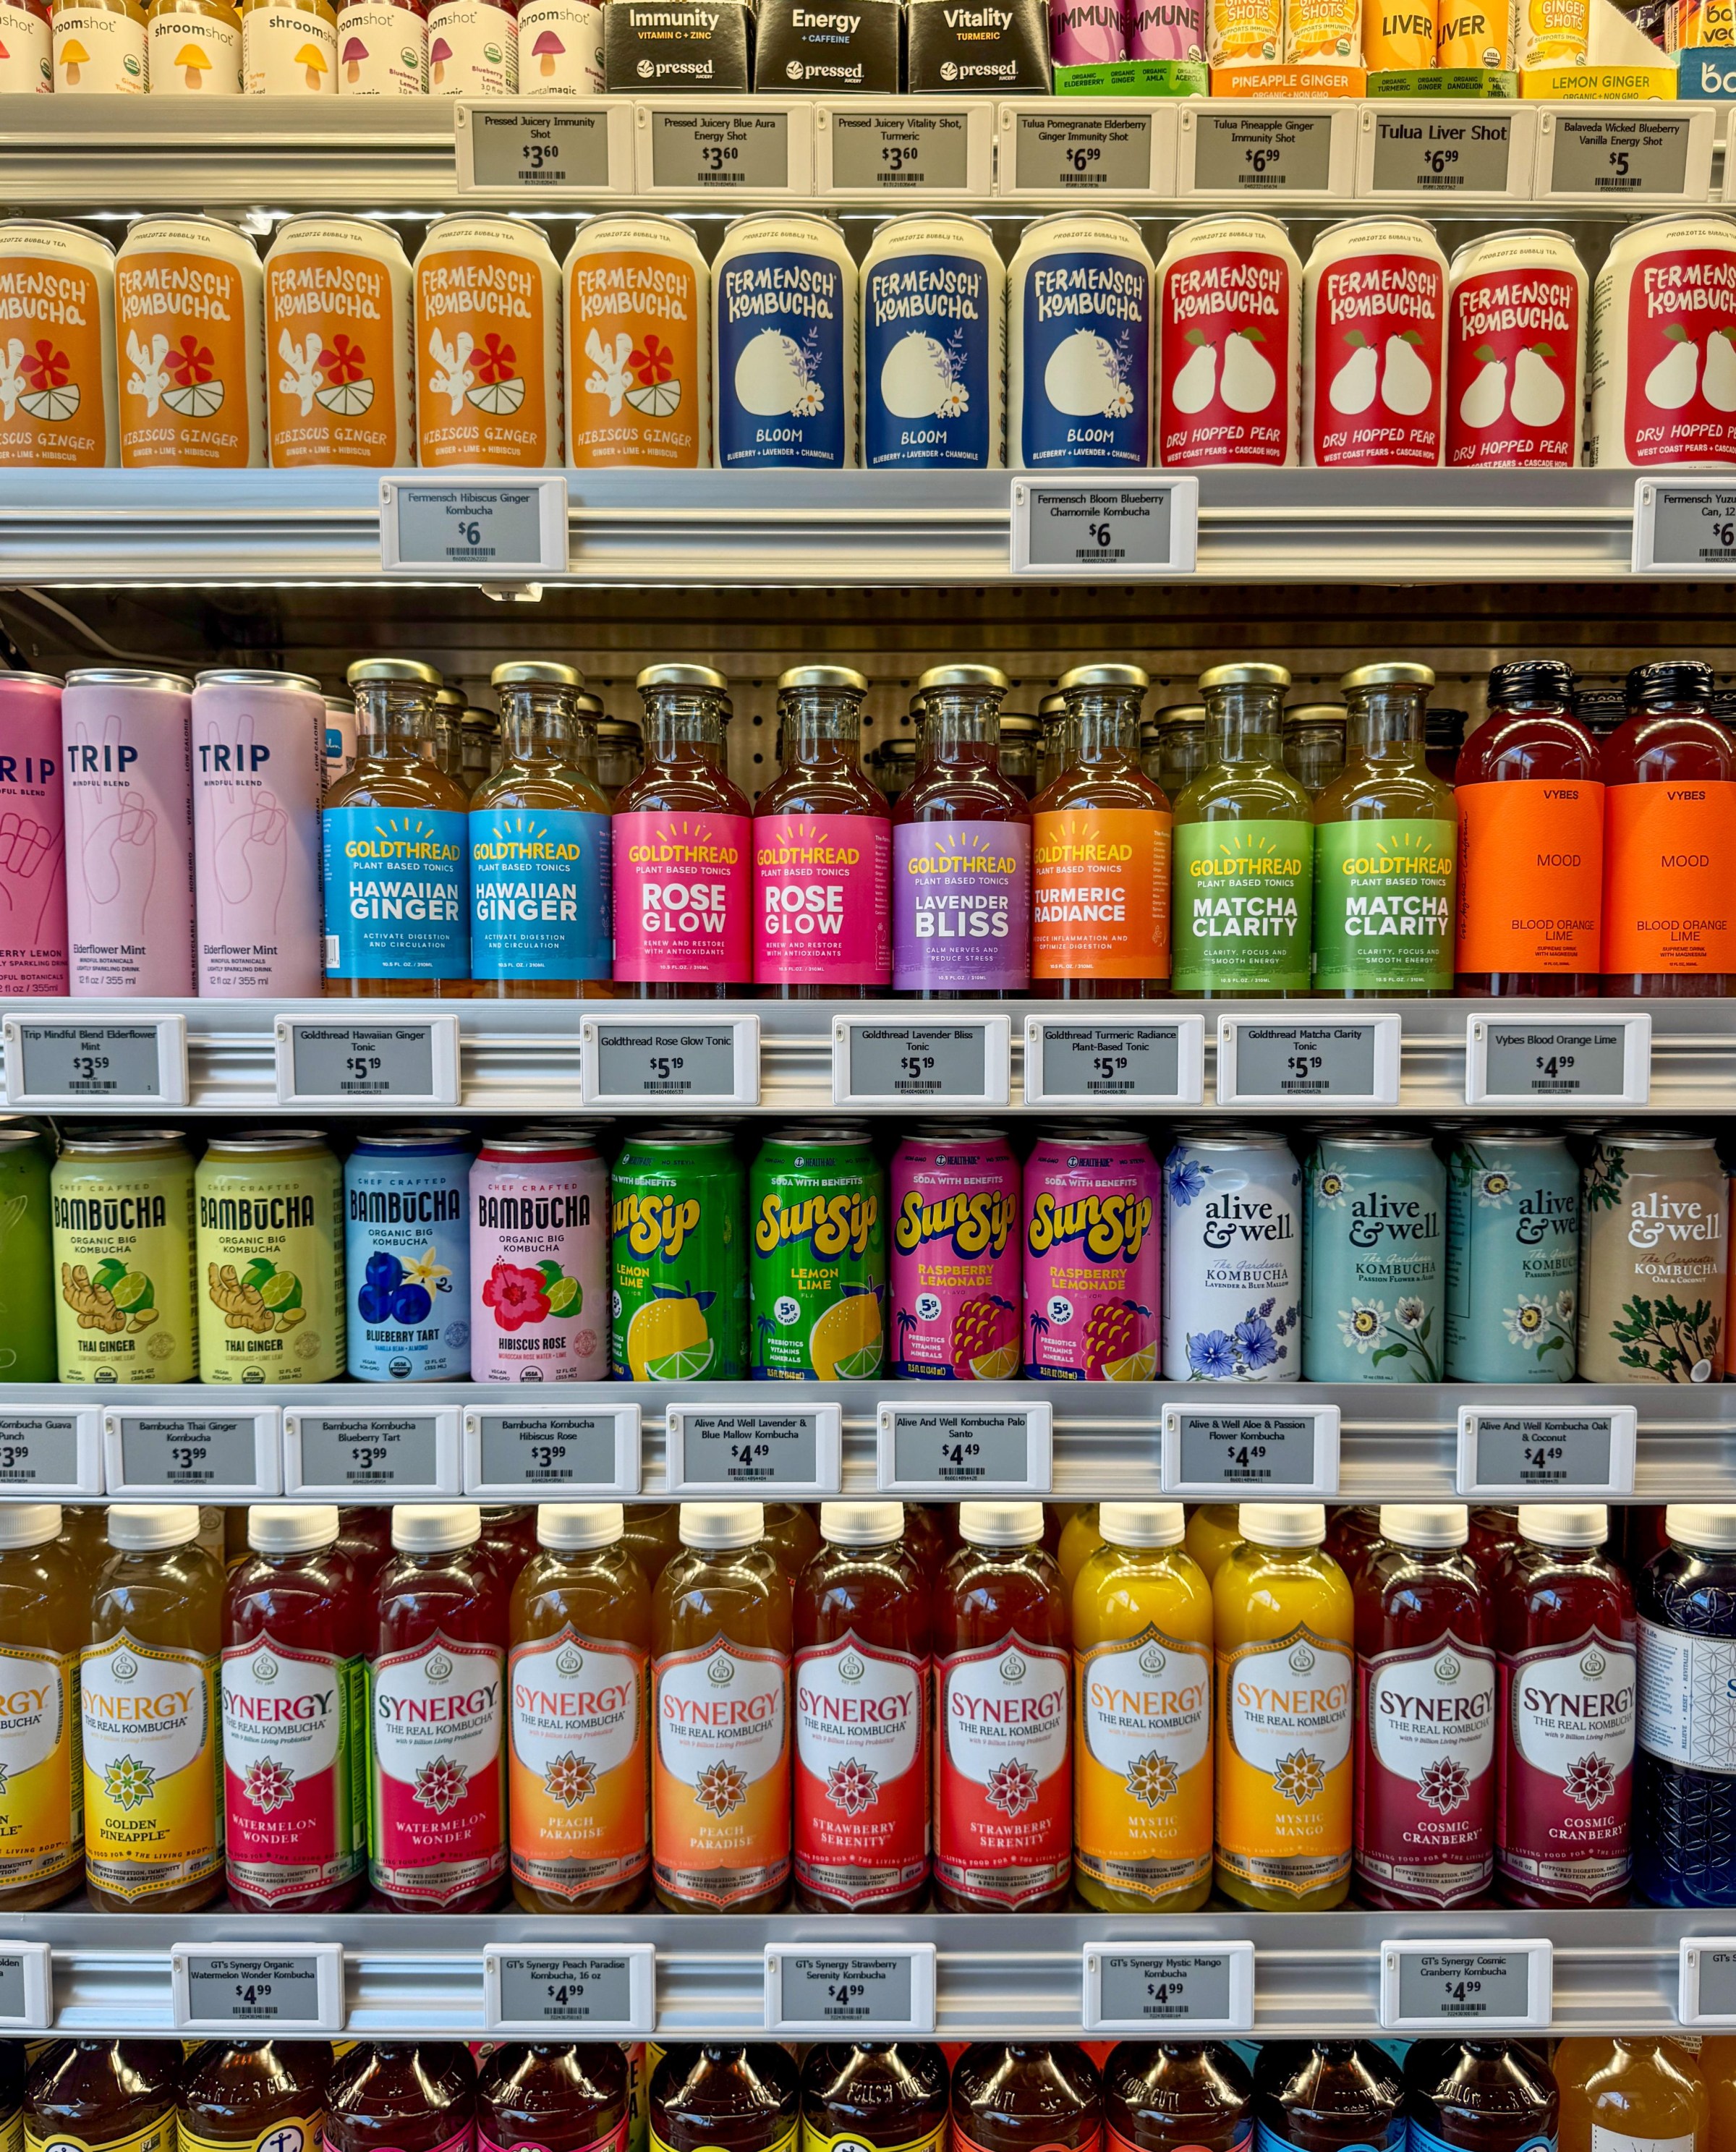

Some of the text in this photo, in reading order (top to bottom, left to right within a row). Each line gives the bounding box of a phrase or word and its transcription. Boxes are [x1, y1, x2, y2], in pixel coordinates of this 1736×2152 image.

[629, 9, 720, 30] Immunity
[793, 10, 861, 34] Energy
[943, 8, 1013, 30] Vitality
[1382, 14, 1432, 40] LIVER
[960, 61, 1018, 80] pressed
[1232, 75, 1348, 88] PINEAPPLE GINGER
[1552, 75, 1649, 89] LEMON GINGER
[839, 118, 961, 129] Pressed Juicery Vitality Shot,
[1021, 119, 1146, 131] Tulua Pomegranate Elderberry
[1565, 122, 1680, 135] Balaveda Wicked Blueberry
[880, 131, 919, 140] Turmeric
[1039, 132, 1128, 143] Ginger Immunity Shot
[1378, 124, 1507, 140] Tulua Liver Shot
[1579, 135, 1663, 147] Vanilla Energy Shot
[1609, 152, 1629, 176] $5
[424, 426, 537, 445] HIBISCUS GINGER
[756, 428, 802, 442] BLOOM
[1167, 426, 1280, 448] DRY HOPPED PEAR
[409, 493, 530, 504] Fermensch Hibiscus Ginger
[1038, 493, 1164, 505] Fermensch Bloom Blueberry
[446, 506, 493, 515] Kombucha
[1050, 506, 1150, 516] Chamomile Kombucha
[459, 522, 480, 545] $6
[1089, 523, 1111, 547] $6
[199, 744, 270, 772] TRIP
[1667, 791, 1706, 800] VYBES
[345, 841, 459, 861] GOLDTHREAD
[387, 862, 420, 871] BASED
[1661, 855, 1709, 867] MOOD
[349, 881, 459, 899] HAWAIIAN
[642, 883, 726, 911] ROSE
[916, 896, 1008, 911] LAVENDER
[350, 898, 459, 922] GINGER
[1194, 897, 1298, 917] MATCHA
[641, 911, 726, 932] GLOW
[915, 911, 1009, 937] BLISS
[1193, 917, 1297, 938] CLARITY
[1638, 920, 1727, 930] BLOOD ORANGE
[1671, 931, 1701, 941] LIME
[204, 945, 278, 955] Elderflower Mint
[23, 1029, 156, 1042] Trip Mindful Blend Elderflower
[1045, 1031, 1092, 1039] Goldthread
[1137, 1030, 1176, 1039] Radiance
[1495, 1035, 1617, 1047] Vybes Blood Orange Lime
[1073, 1042, 1149, 1051] Plant-Based Tonic
[1045, 1178, 1137, 1187] SODA WITH BENEFITS
[1206, 1194, 1272, 1220] alive
[224, 1245, 281, 1254] KOMBUCHA
[791, 1268, 839, 1280] LEMON
[1050, 1267, 1127, 1280] RASPBERRY
[1207, 1269, 1288, 1281] KOMBUCHA
[799, 1279, 831, 1290] LIME
[1052, 1279, 1124, 1290] LEMONADE
[367, 1328, 440, 1342] BLUEBERRY TART
[225, 1339, 284, 1352] THAI GINGER
[187, 1421, 205, 1430] Thai
[208, 1422, 237, 1432] Ginger
[897, 1418, 917, 1426] Alive
[1008, 1417, 1025, 1426] Palo
[166, 1433, 211, 1442] Kombucha
[378, 1681, 497, 1722] SYNERGY
[386, 1724, 405, 1735] THE
[407, 1721, 433, 1733] REAL
[105, 1818, 157, 1829] GOLDEN
[396, 1812, 487, 1834] WATERMELON
[813, 1816, 895, 1835] STRAWBERRY
[1418, 1821, 1468, 1832] COSMIC
[699, 1824, 744, 1837] PEACH
[230, 1961, 262, 1970] Synergy
[263, 1961, 294, 1970] Organic
[816, 1960, 848, 1970] Synergy
[851, 1960, 897, 1970] Strawberry
[1442, 1957, 1474, 1967] Synergy
[807, 1970, 886, 1981] Serenity Kombucha
[1421, 1967, 1507, 1977] Cranberry Kombucha
